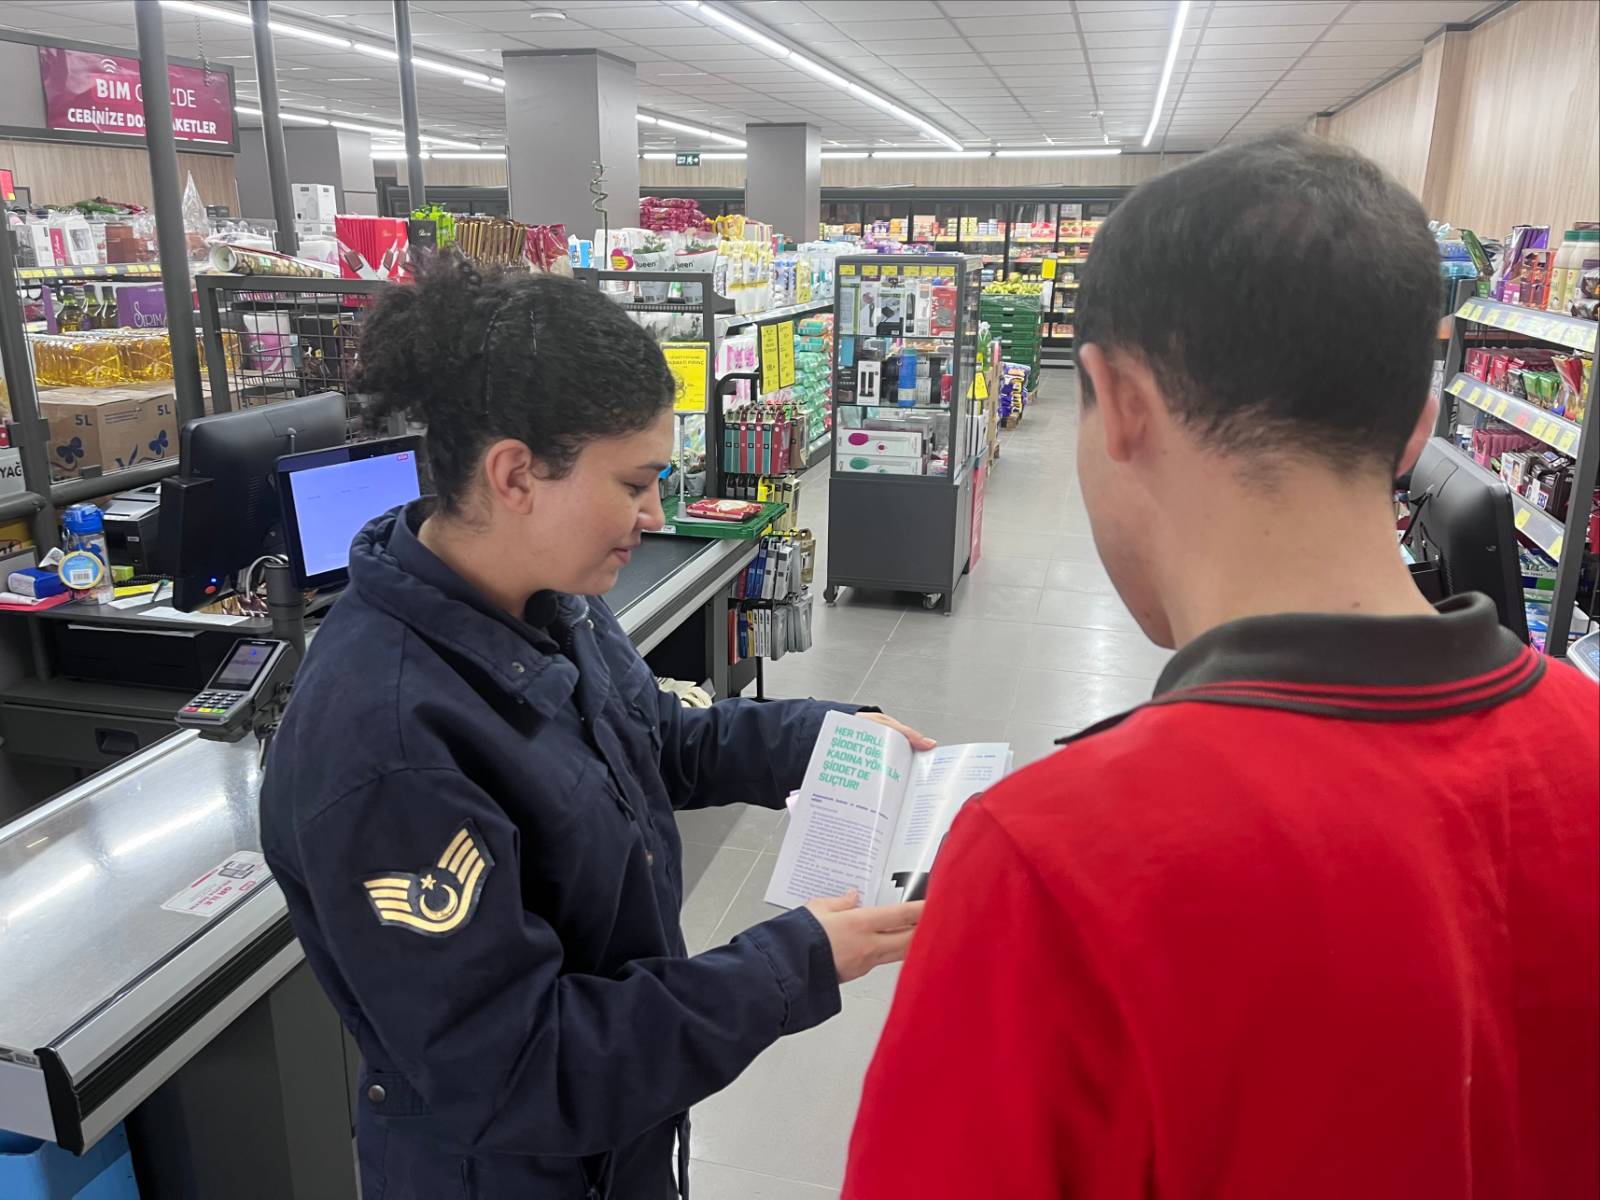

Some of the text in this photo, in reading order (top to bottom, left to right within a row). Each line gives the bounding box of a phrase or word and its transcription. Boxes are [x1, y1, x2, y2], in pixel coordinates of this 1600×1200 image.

[96, 78, 131, 101] BIM
[67, 106, 124, 127] CEBİNİZE
[75, 414, 93, 426] 5L
[835, 726, 854, 738] HER
[826, 748, 863, 766] KADINA
[857, 769, 871, 781] DE
